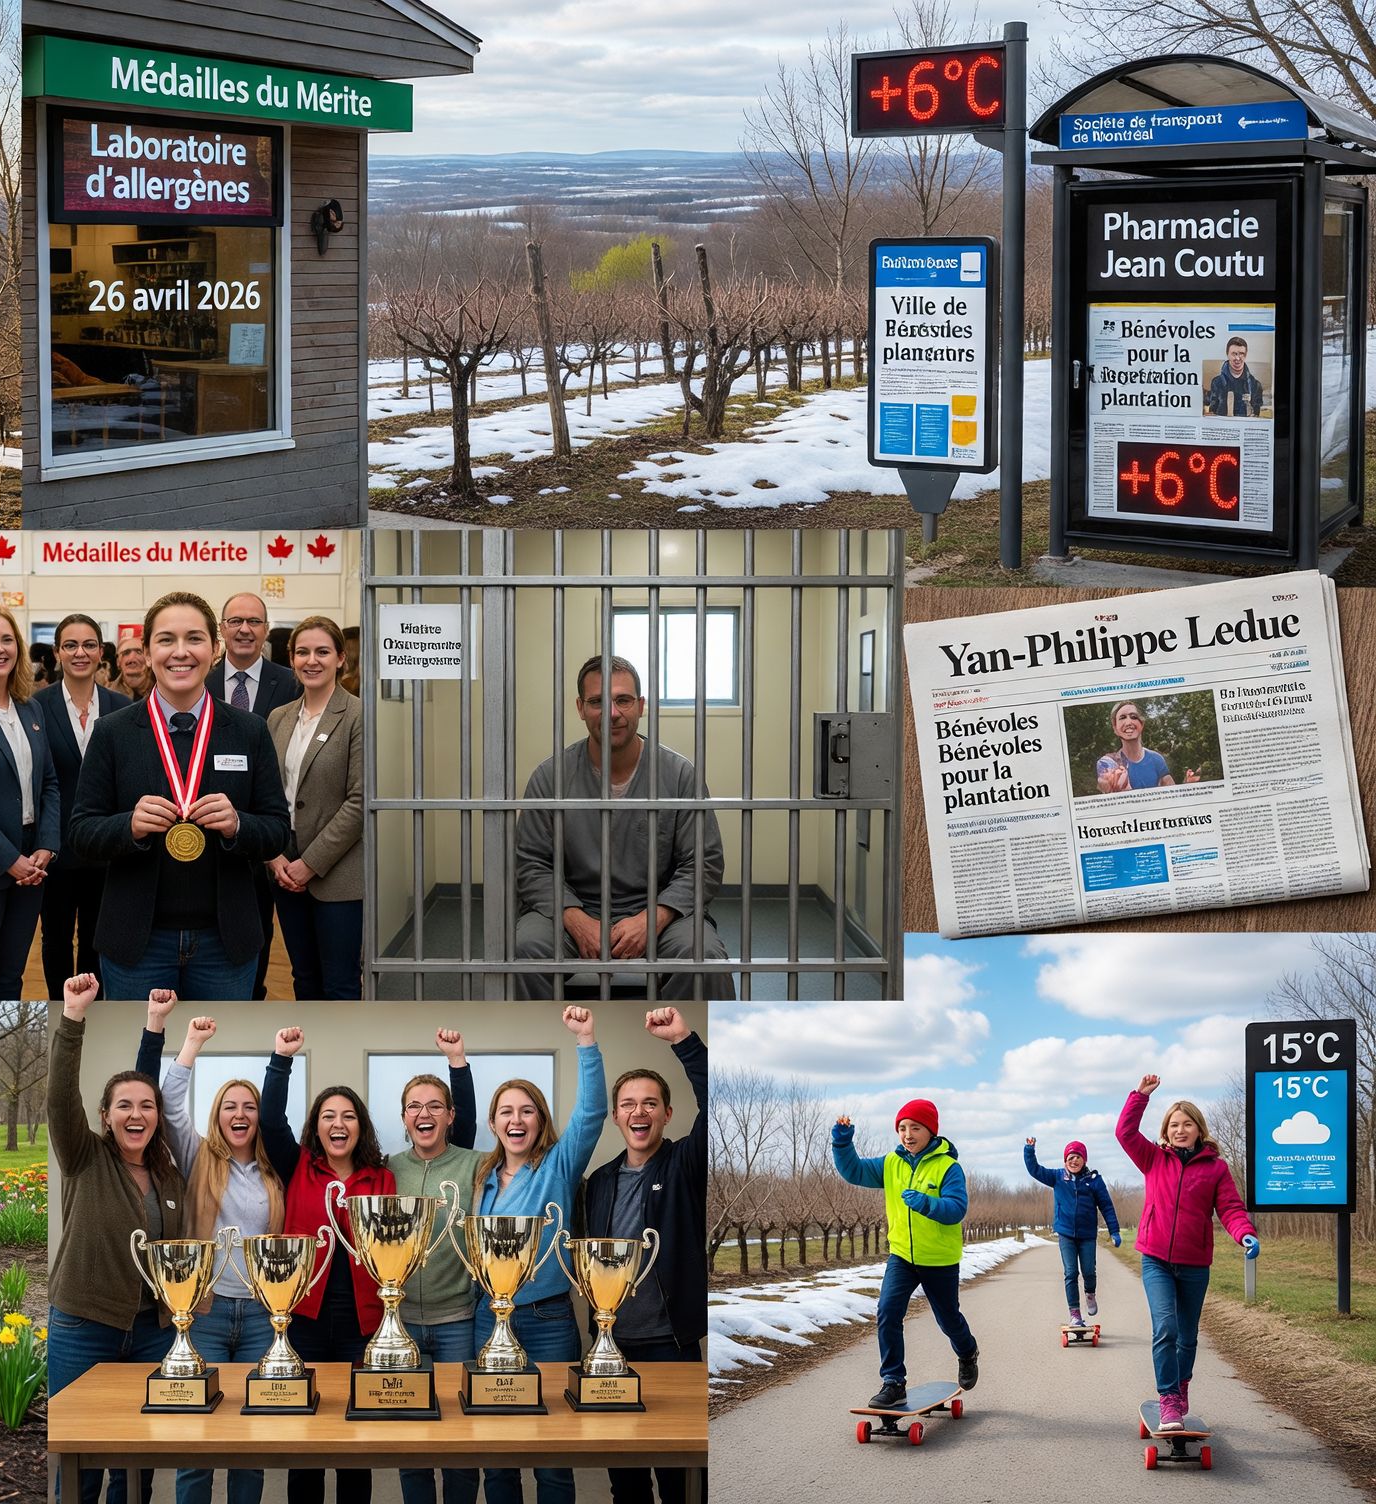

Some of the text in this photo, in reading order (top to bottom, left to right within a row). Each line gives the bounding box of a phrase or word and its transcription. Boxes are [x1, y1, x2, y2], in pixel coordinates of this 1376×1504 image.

[111, 57, 372, 117] Médailles du Mérite
[870, 55, 999, 120] +6°C
[90, 124, 246, 166] Laboratoire
[1104, 209, 1258, 240] Pharmacie
[1100, 249, 1264, 278] Jean Coutu
[88, 280, 261, 312] 26 avril 2026
[891, 296, 967, 316] Ville de
[1121, 319, 1215, 340] Bénévoles
[1127, 344, 1190, 366] pour la
[1101, 388, 1191, 410] plantation
[1120, 451, 1238, 510] +6°C
[43, 541, 248, 563] Médailles du Mérite
[939, 608, 1301, 677] Yan-Philippe Leduc
[935, 711, 1039, 740] Bénévoles
[938, 735, 1042, 764] Bénévoles
[941, 760, 1013, 790] pour la
[943, 783, 1051, 813] plantation
[1263, 1032, 1340, 1064] 15°C
[1273, 1076, 1329, 1099] 15°C
